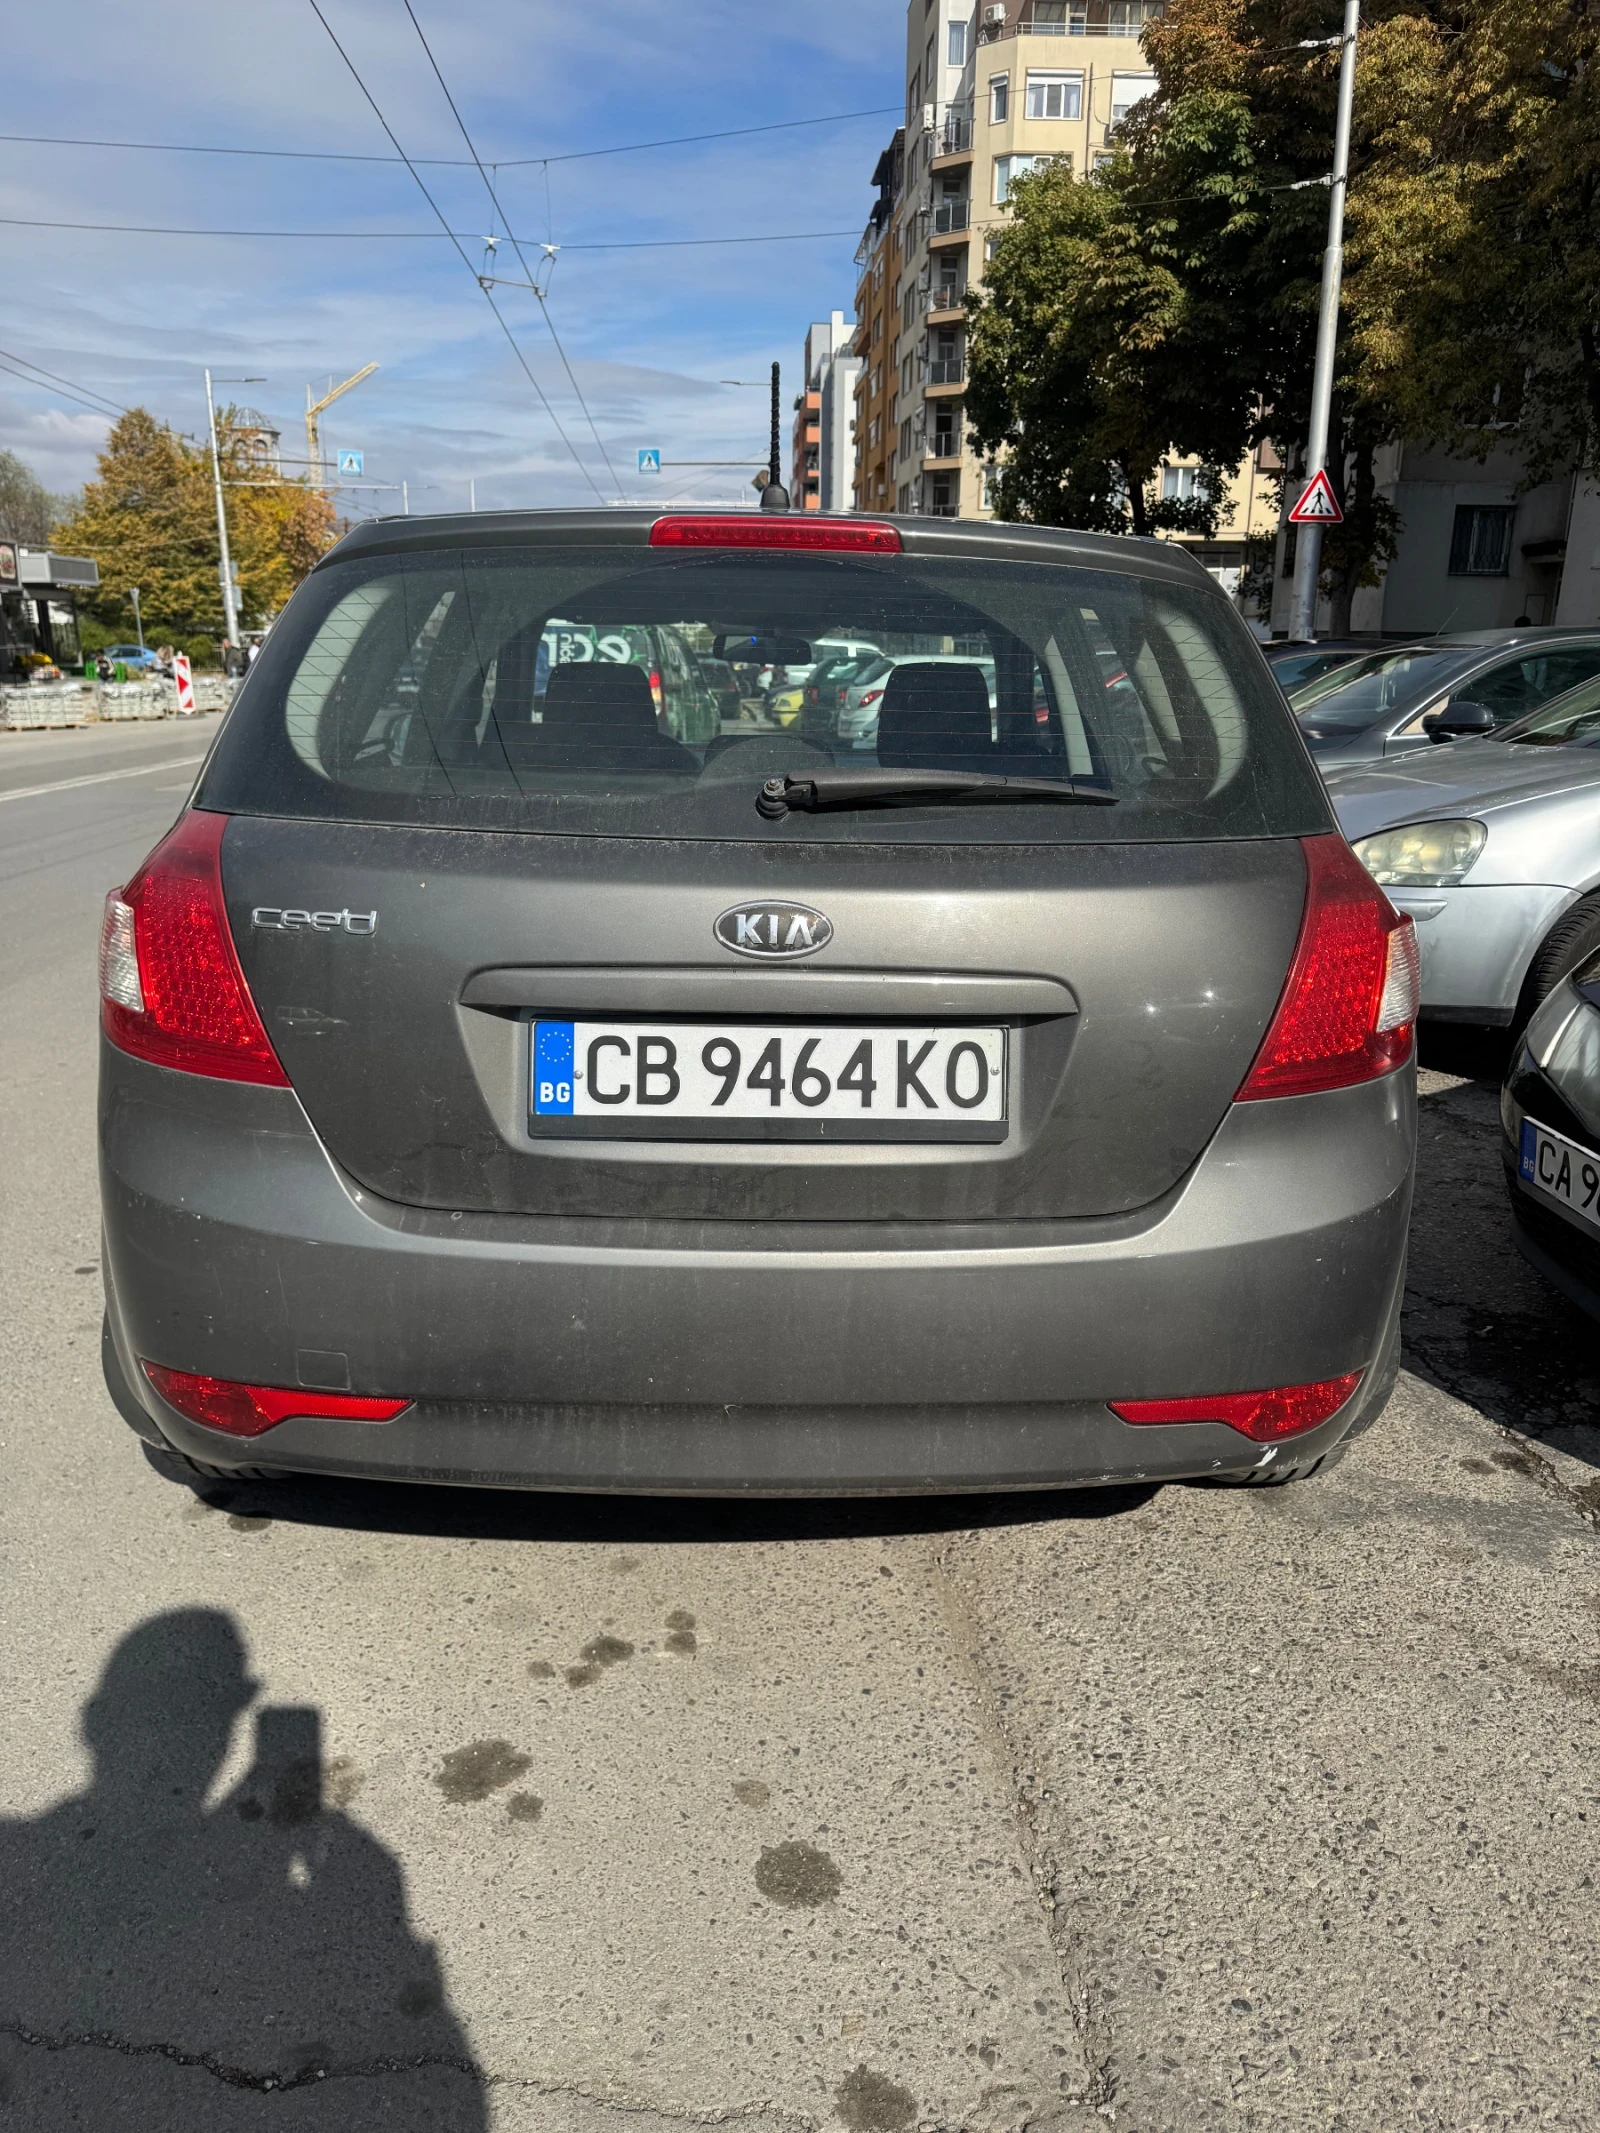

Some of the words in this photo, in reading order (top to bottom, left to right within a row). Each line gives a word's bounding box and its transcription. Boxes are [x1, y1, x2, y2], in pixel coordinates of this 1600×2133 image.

[735, 913, 813, 945] KIA
[587, 1036, 680, 1105] CB
[701, 1037, 877, 1107] 9464
[896, 1040, 988, 1108] KO
[540, 1082, 570, 1102] BG
[1523, 1156, 1534, 1173] BG
[1539, 1141, 1571, 1198] CA
[1581, 1164, 1600, 1218] 9
